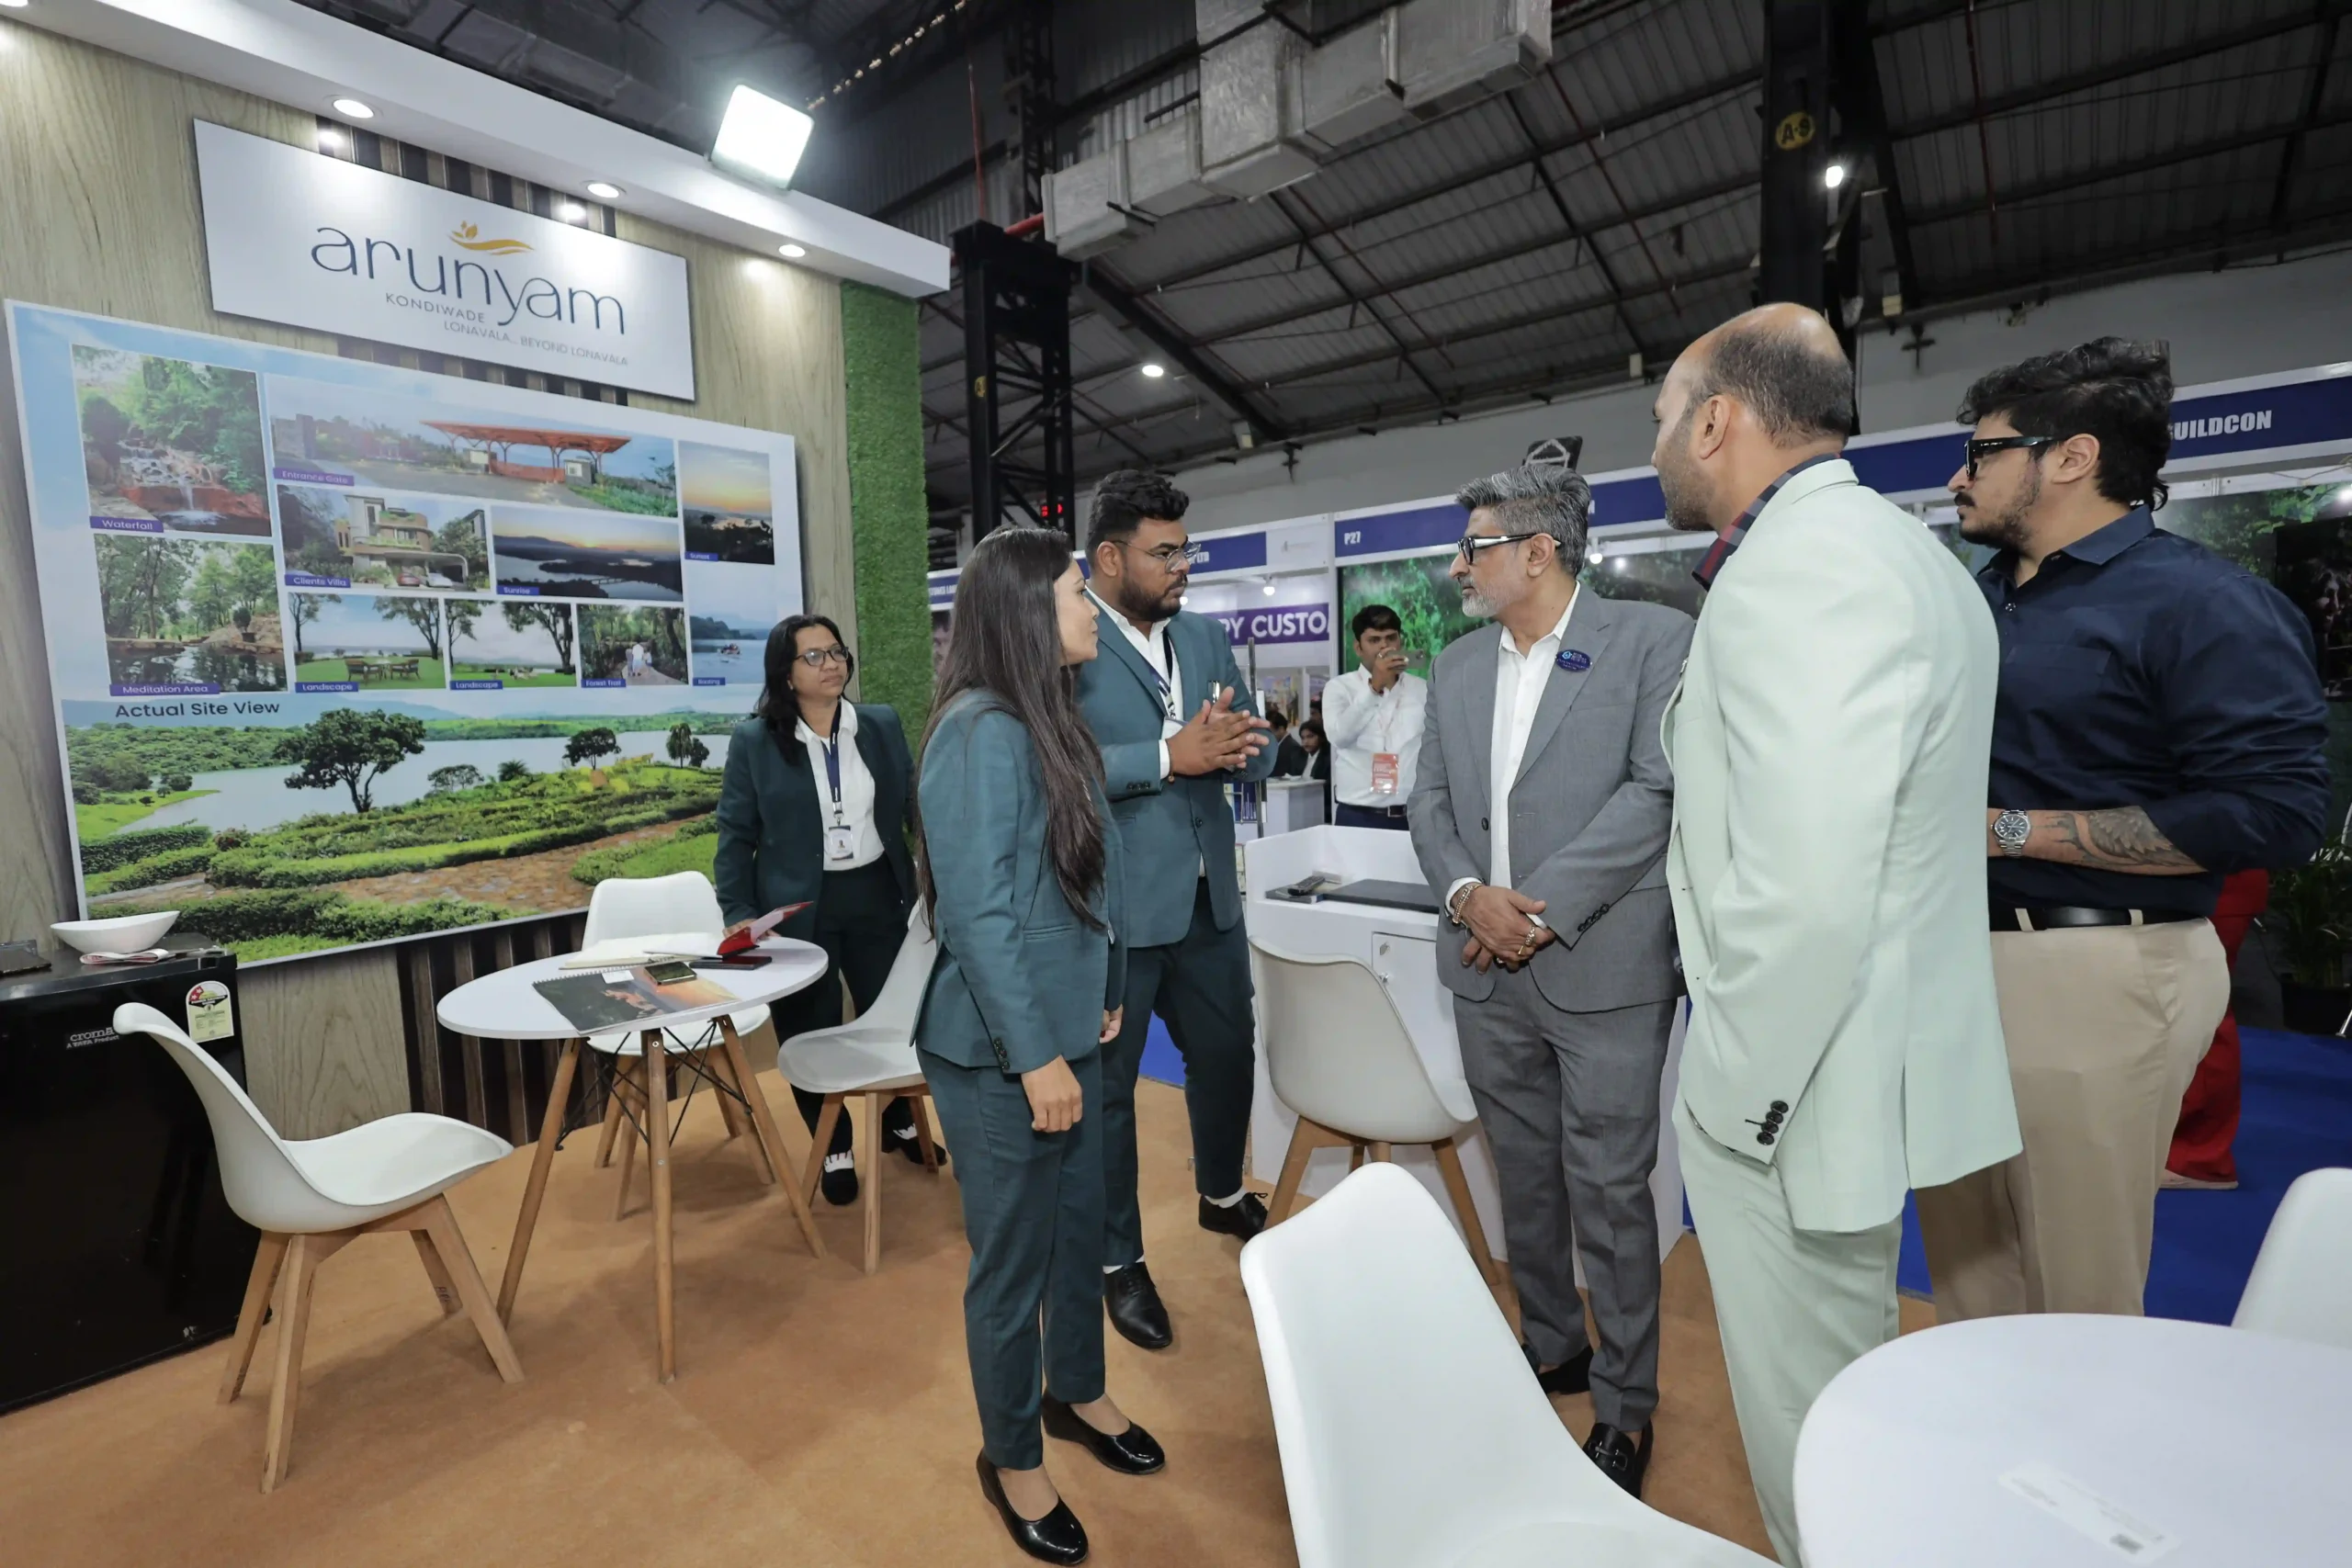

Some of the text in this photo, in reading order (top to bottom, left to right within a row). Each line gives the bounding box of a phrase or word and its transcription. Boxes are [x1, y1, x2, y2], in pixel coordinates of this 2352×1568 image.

[311, 227, 625, 335] arunyam
[385, 292, 485, 322] KONDIWADE
[521, 335, 569, 355] BEYOND
[571, 346, 628, 367] LONAVALA
[281, 469, 349, 484] Entrance Gate
[101, 519, 153, 531] Waterfall
[1344, 531, 1361, 546] P27
[292, 576, 347, 587] Clients Villa
[503, 586, 531, 594] Sunrise
[1250, 610, 1329, 638] CUSTO
[122, 683, 208, 694] Meditation Area
[302, 682, 353, 692] Landscape
[455, 681, 499, 690] Landscape
[115, 701, 280, 718] Actual Site View
[94, 1034, 119, 1043] Product
